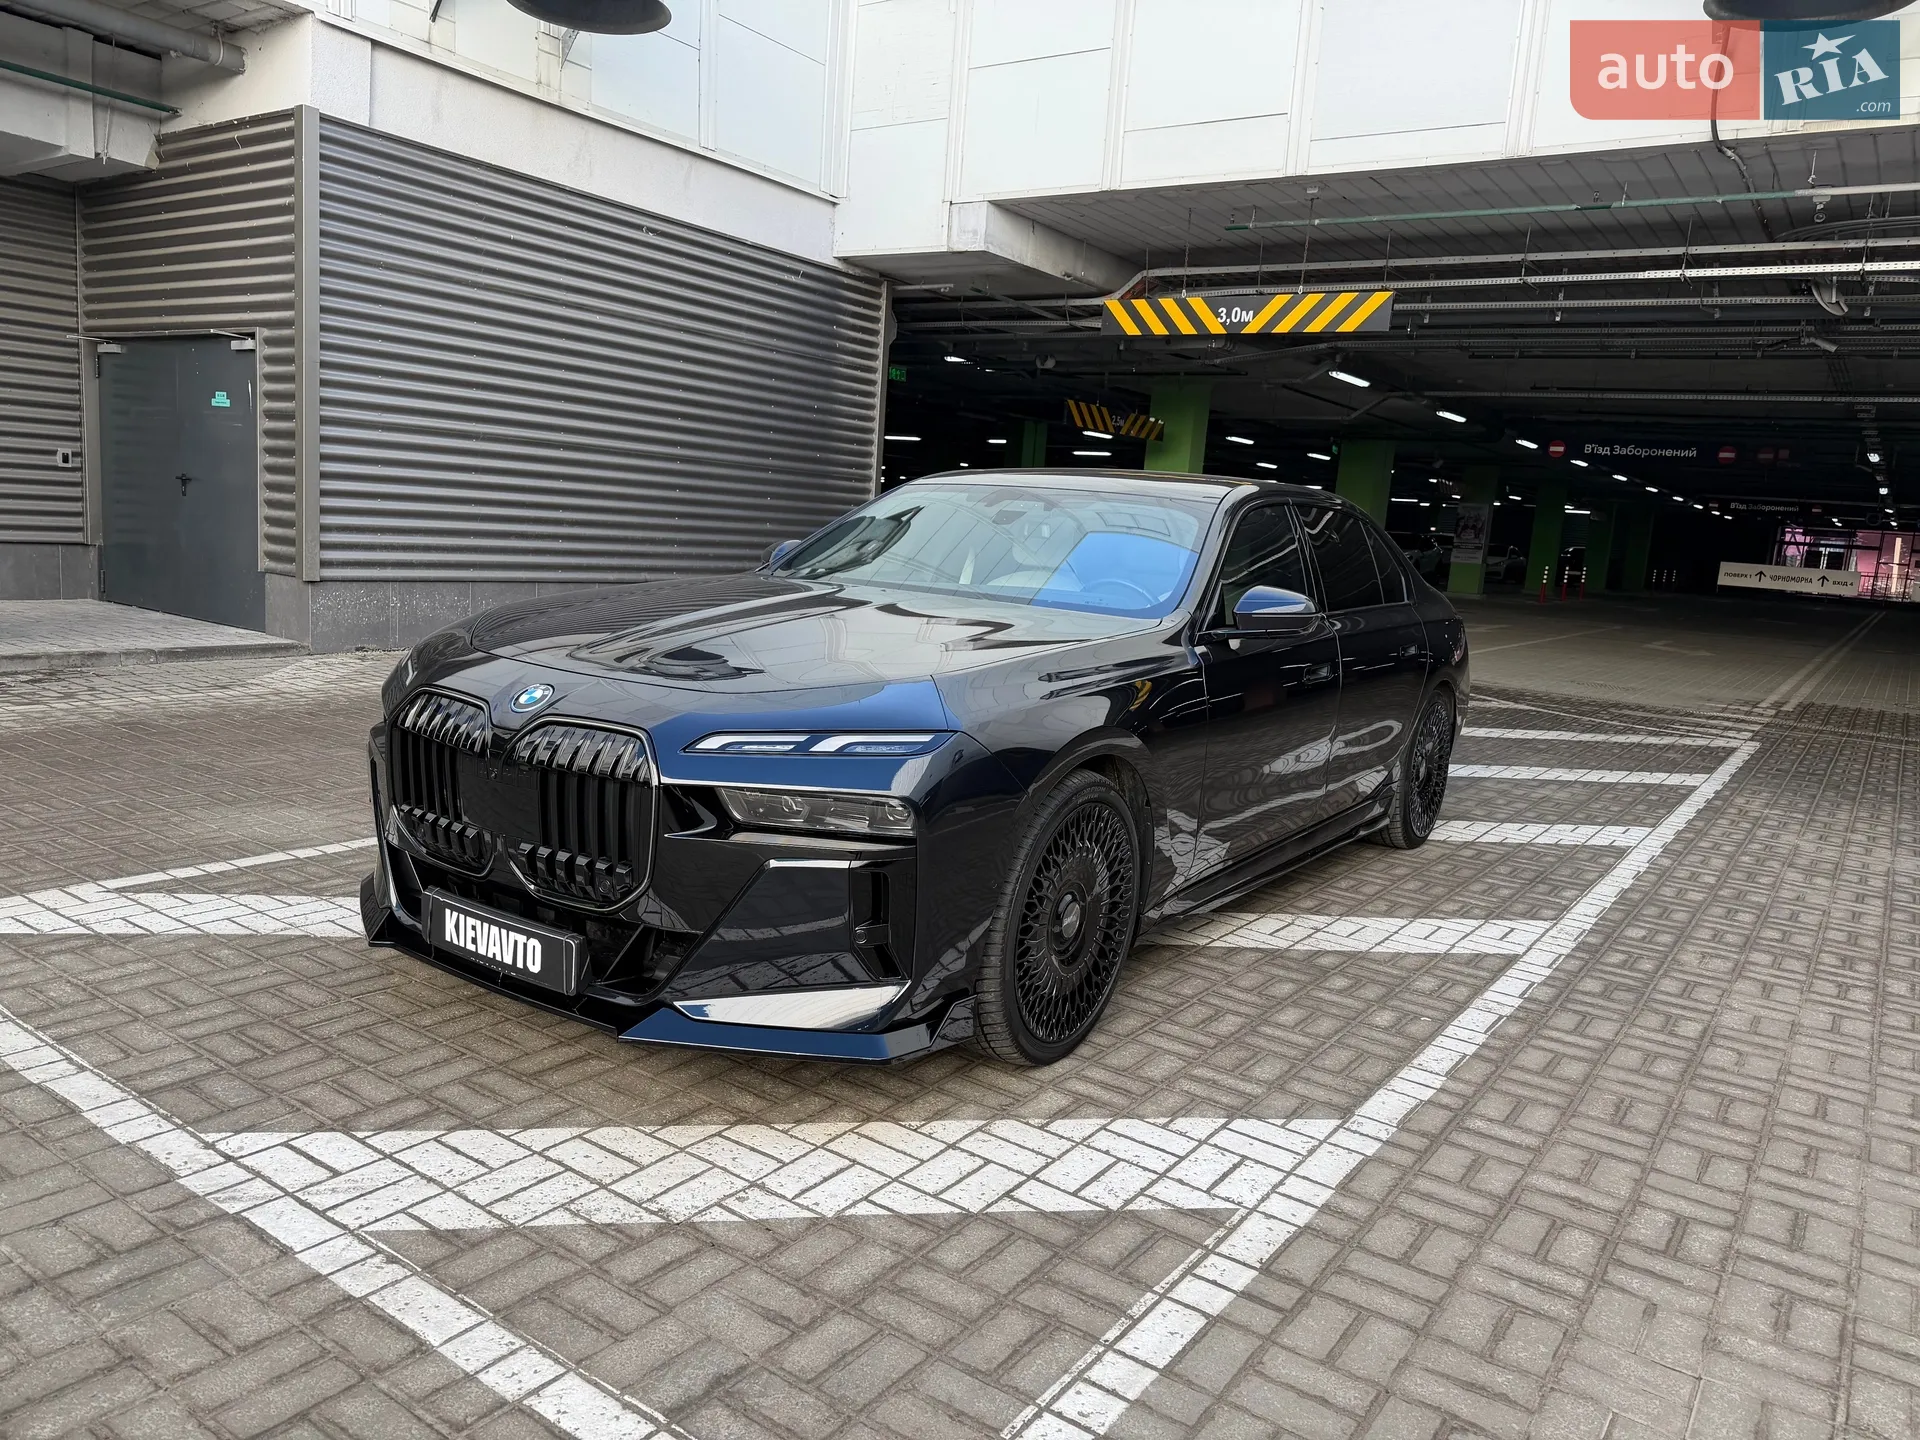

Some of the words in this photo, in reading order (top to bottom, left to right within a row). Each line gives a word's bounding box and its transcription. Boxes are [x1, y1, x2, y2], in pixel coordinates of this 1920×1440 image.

[1612, 445, 1697, 458] Заборонений
[1769, 574, 1813, 584] ЧОРНОМОРКА
[445, 908, 542, 974] KIEVAVTO
